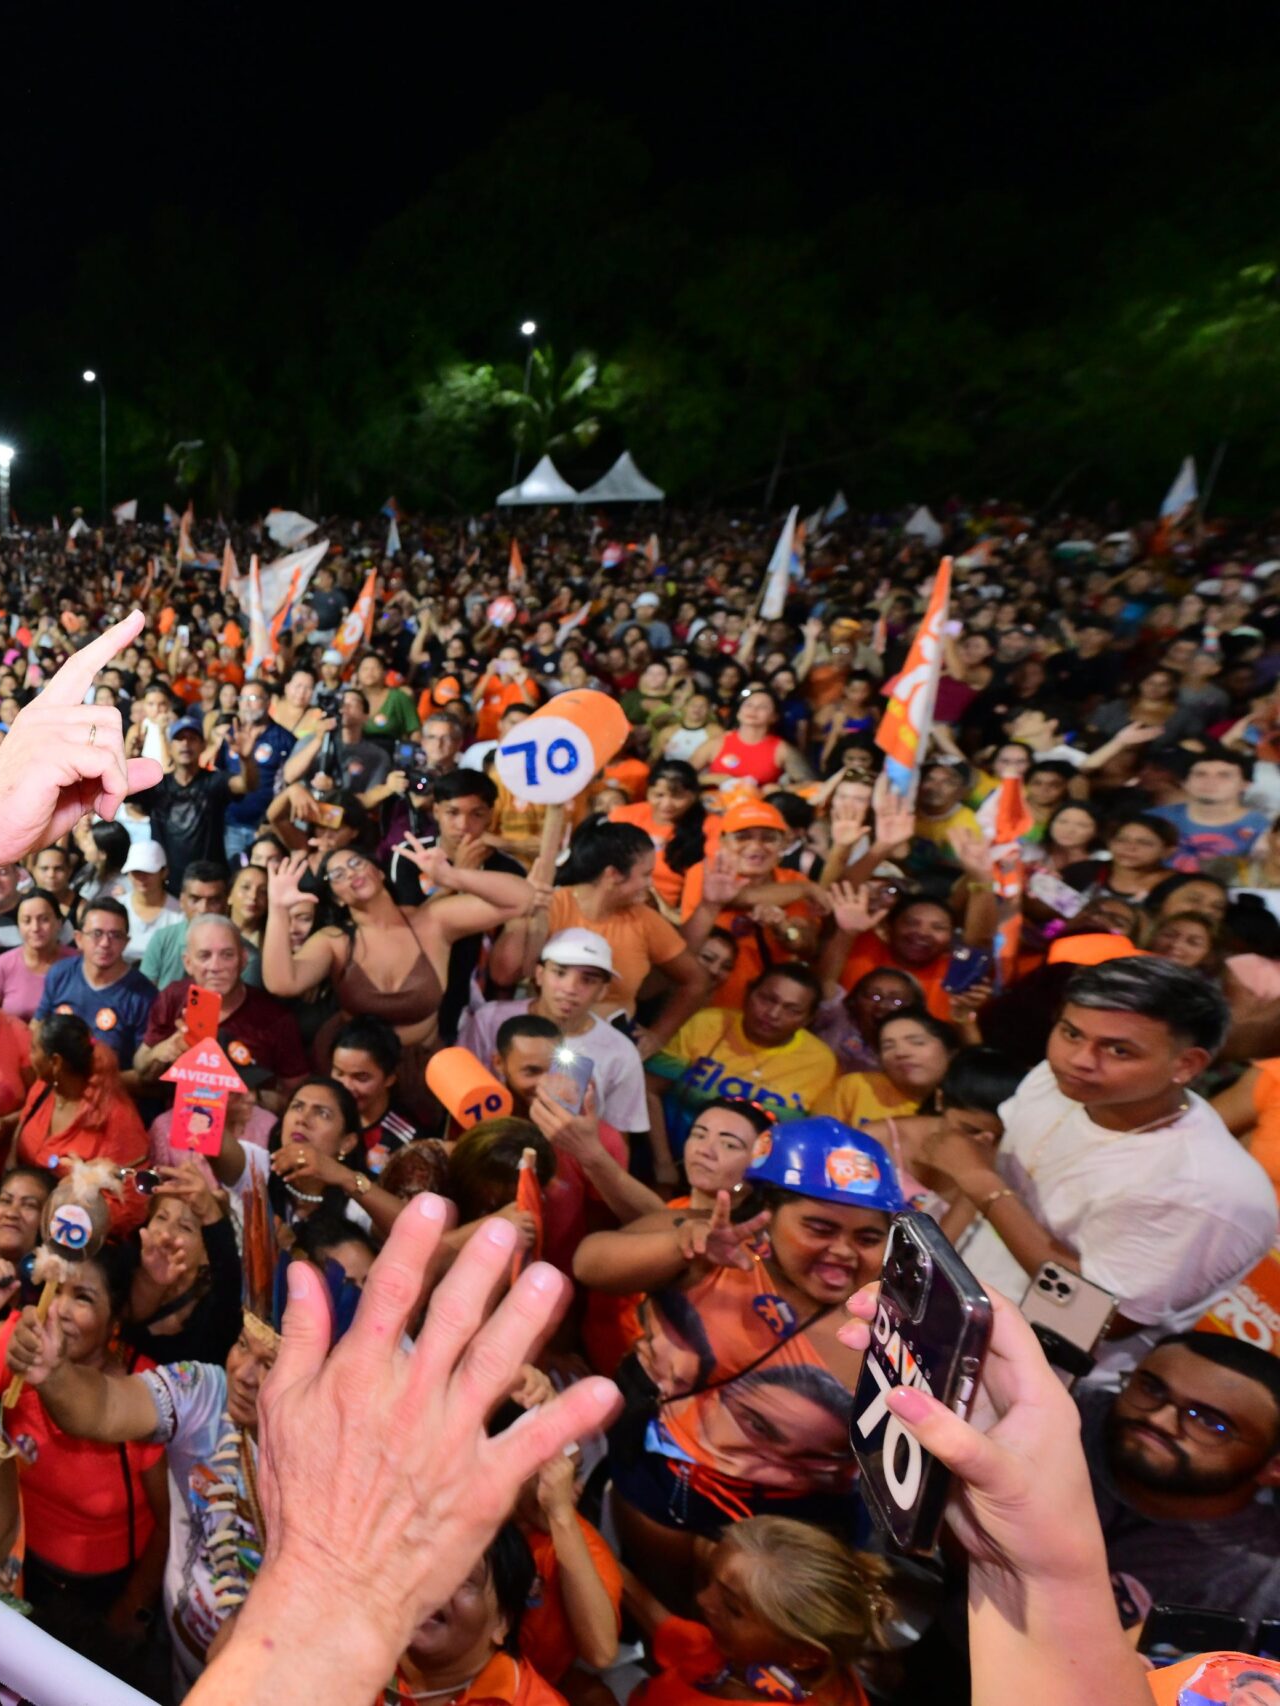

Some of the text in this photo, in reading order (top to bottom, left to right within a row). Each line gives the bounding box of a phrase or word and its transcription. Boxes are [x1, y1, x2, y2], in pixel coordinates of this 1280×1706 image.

[500, 738, 579, 786] 70
[195, 1051, 221, 1069] AS
[463, 1093, 503, 1121] 70
[56, 1216, 88, 1248] 70
